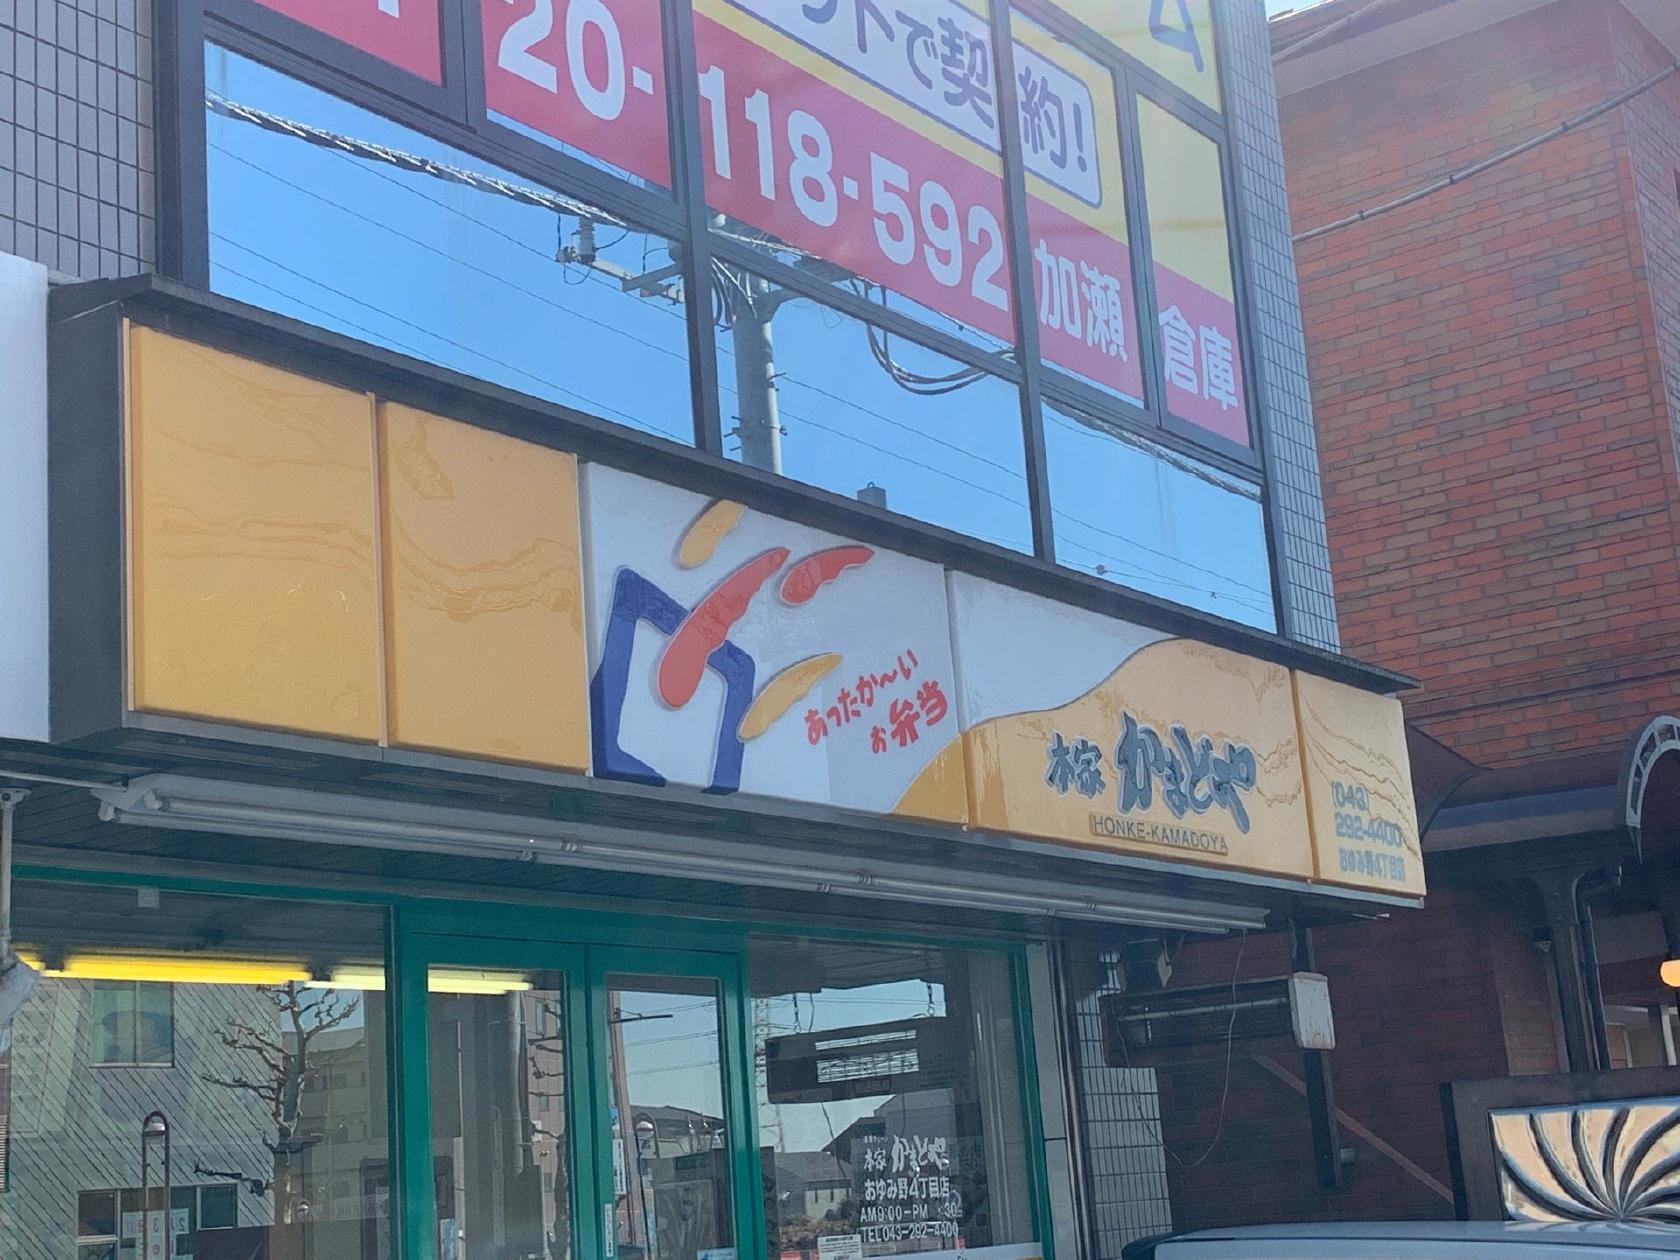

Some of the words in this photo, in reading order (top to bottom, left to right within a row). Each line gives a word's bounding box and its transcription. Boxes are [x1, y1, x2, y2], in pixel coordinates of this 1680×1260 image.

[870, 679, 948, 754] お弁当
[1093, 815, 1229, 852] HONKE-KAMADOYA
[1334, 811, 1403, 849] 292-4400
[864, 1176, 950, 1201] おゆみ野4丁目店
